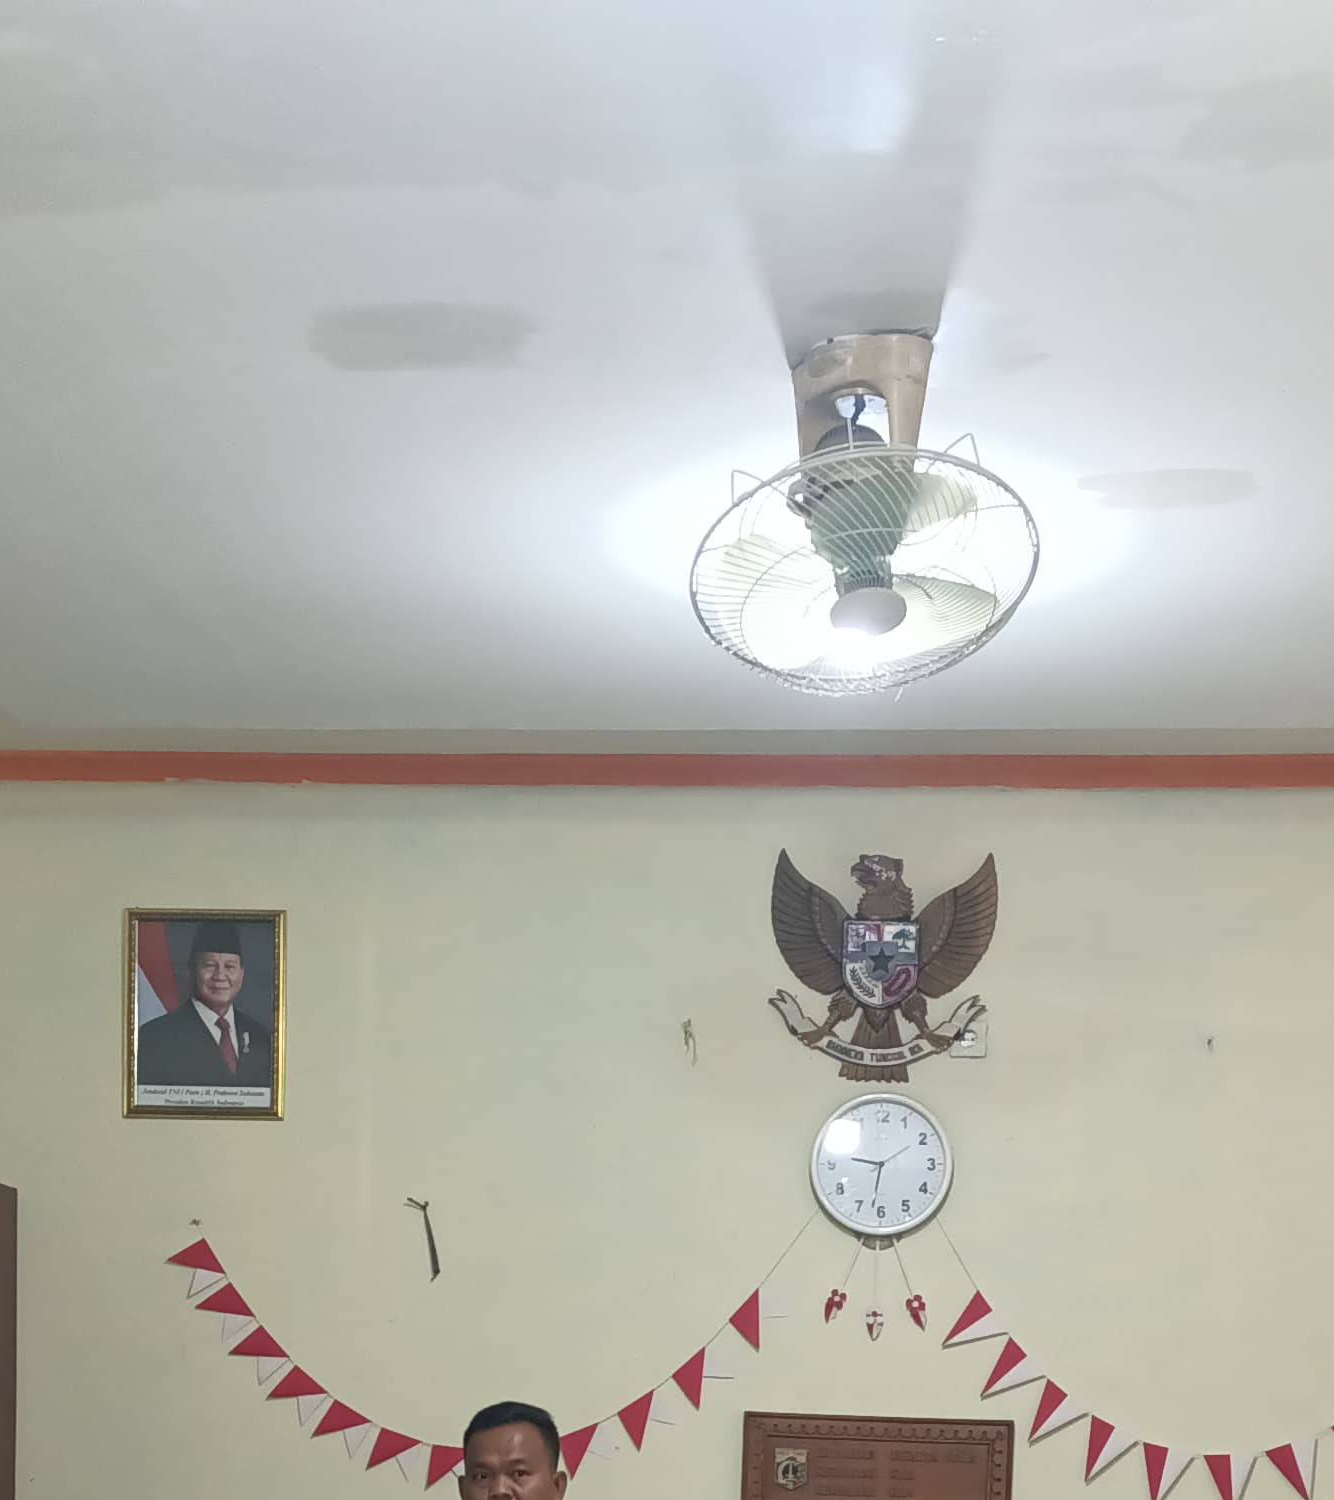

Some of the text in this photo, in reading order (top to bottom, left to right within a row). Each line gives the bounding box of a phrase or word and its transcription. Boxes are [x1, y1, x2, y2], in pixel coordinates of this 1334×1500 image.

[900, 1116, 907, 1129] 1
[918, 1132, 928, 1145] 2
[927, 1158, 936, 1171] 3
[835, 1182, 845, 1195] 8
[918, 1181, 928, 1194] 4
[855, 1200, 864, 1213] 7
[876, 1205, 885, 1218] 6
[901, 1200, 910, 1212] 5
